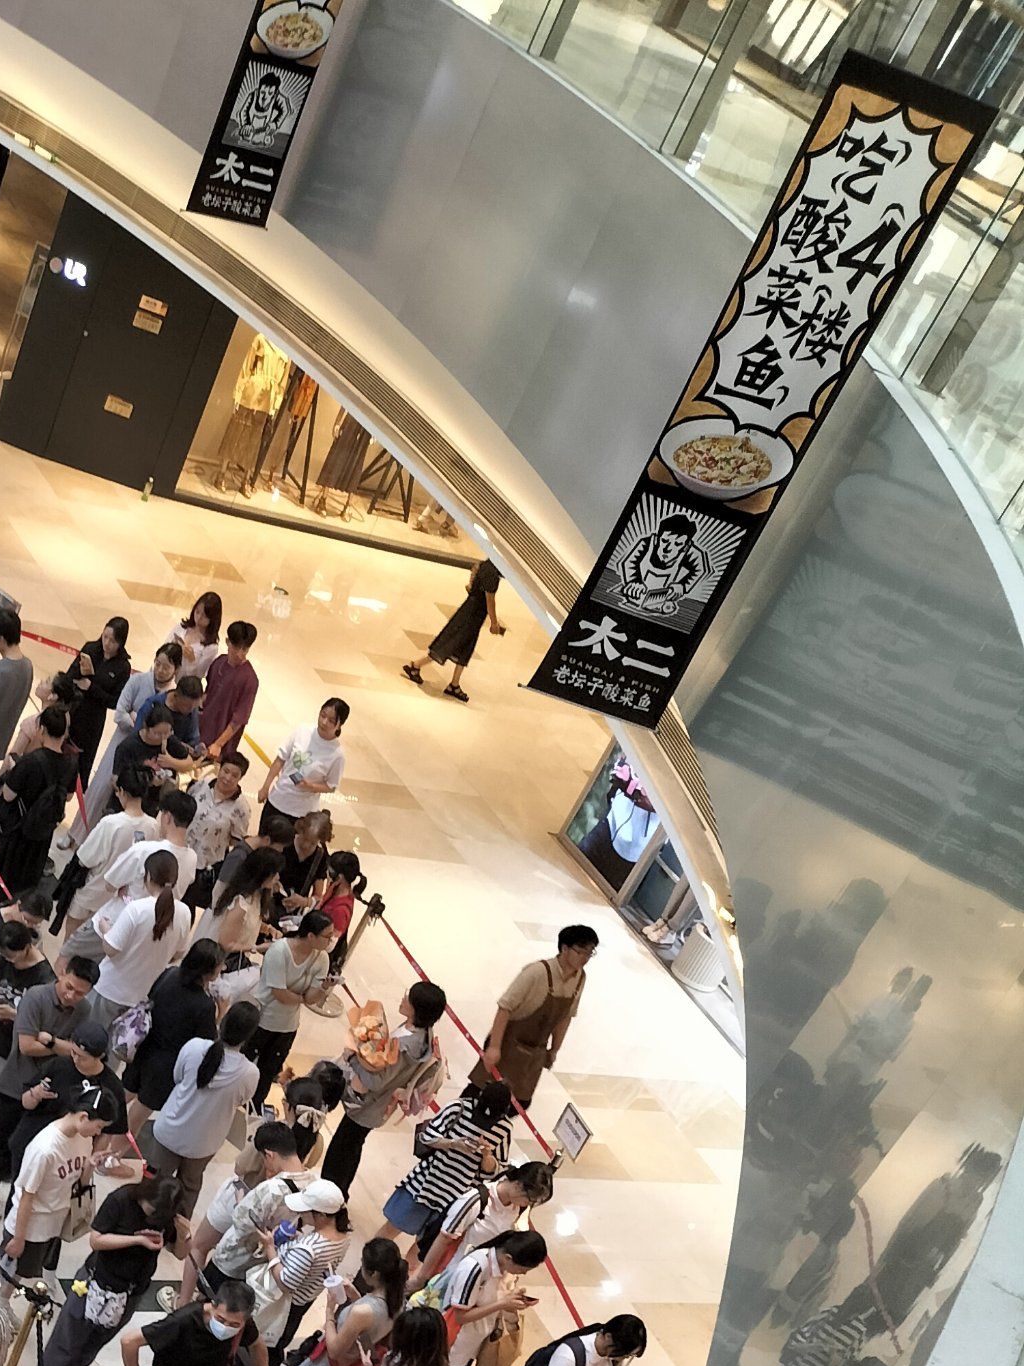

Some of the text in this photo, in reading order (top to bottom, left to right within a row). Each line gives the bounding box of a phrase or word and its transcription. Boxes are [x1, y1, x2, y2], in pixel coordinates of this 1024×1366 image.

[209, 151, 274, 193] 太二
[567, 615, 676, 679] 太二
[551, 664, 652, 713] 老坛子酸菜鱼
